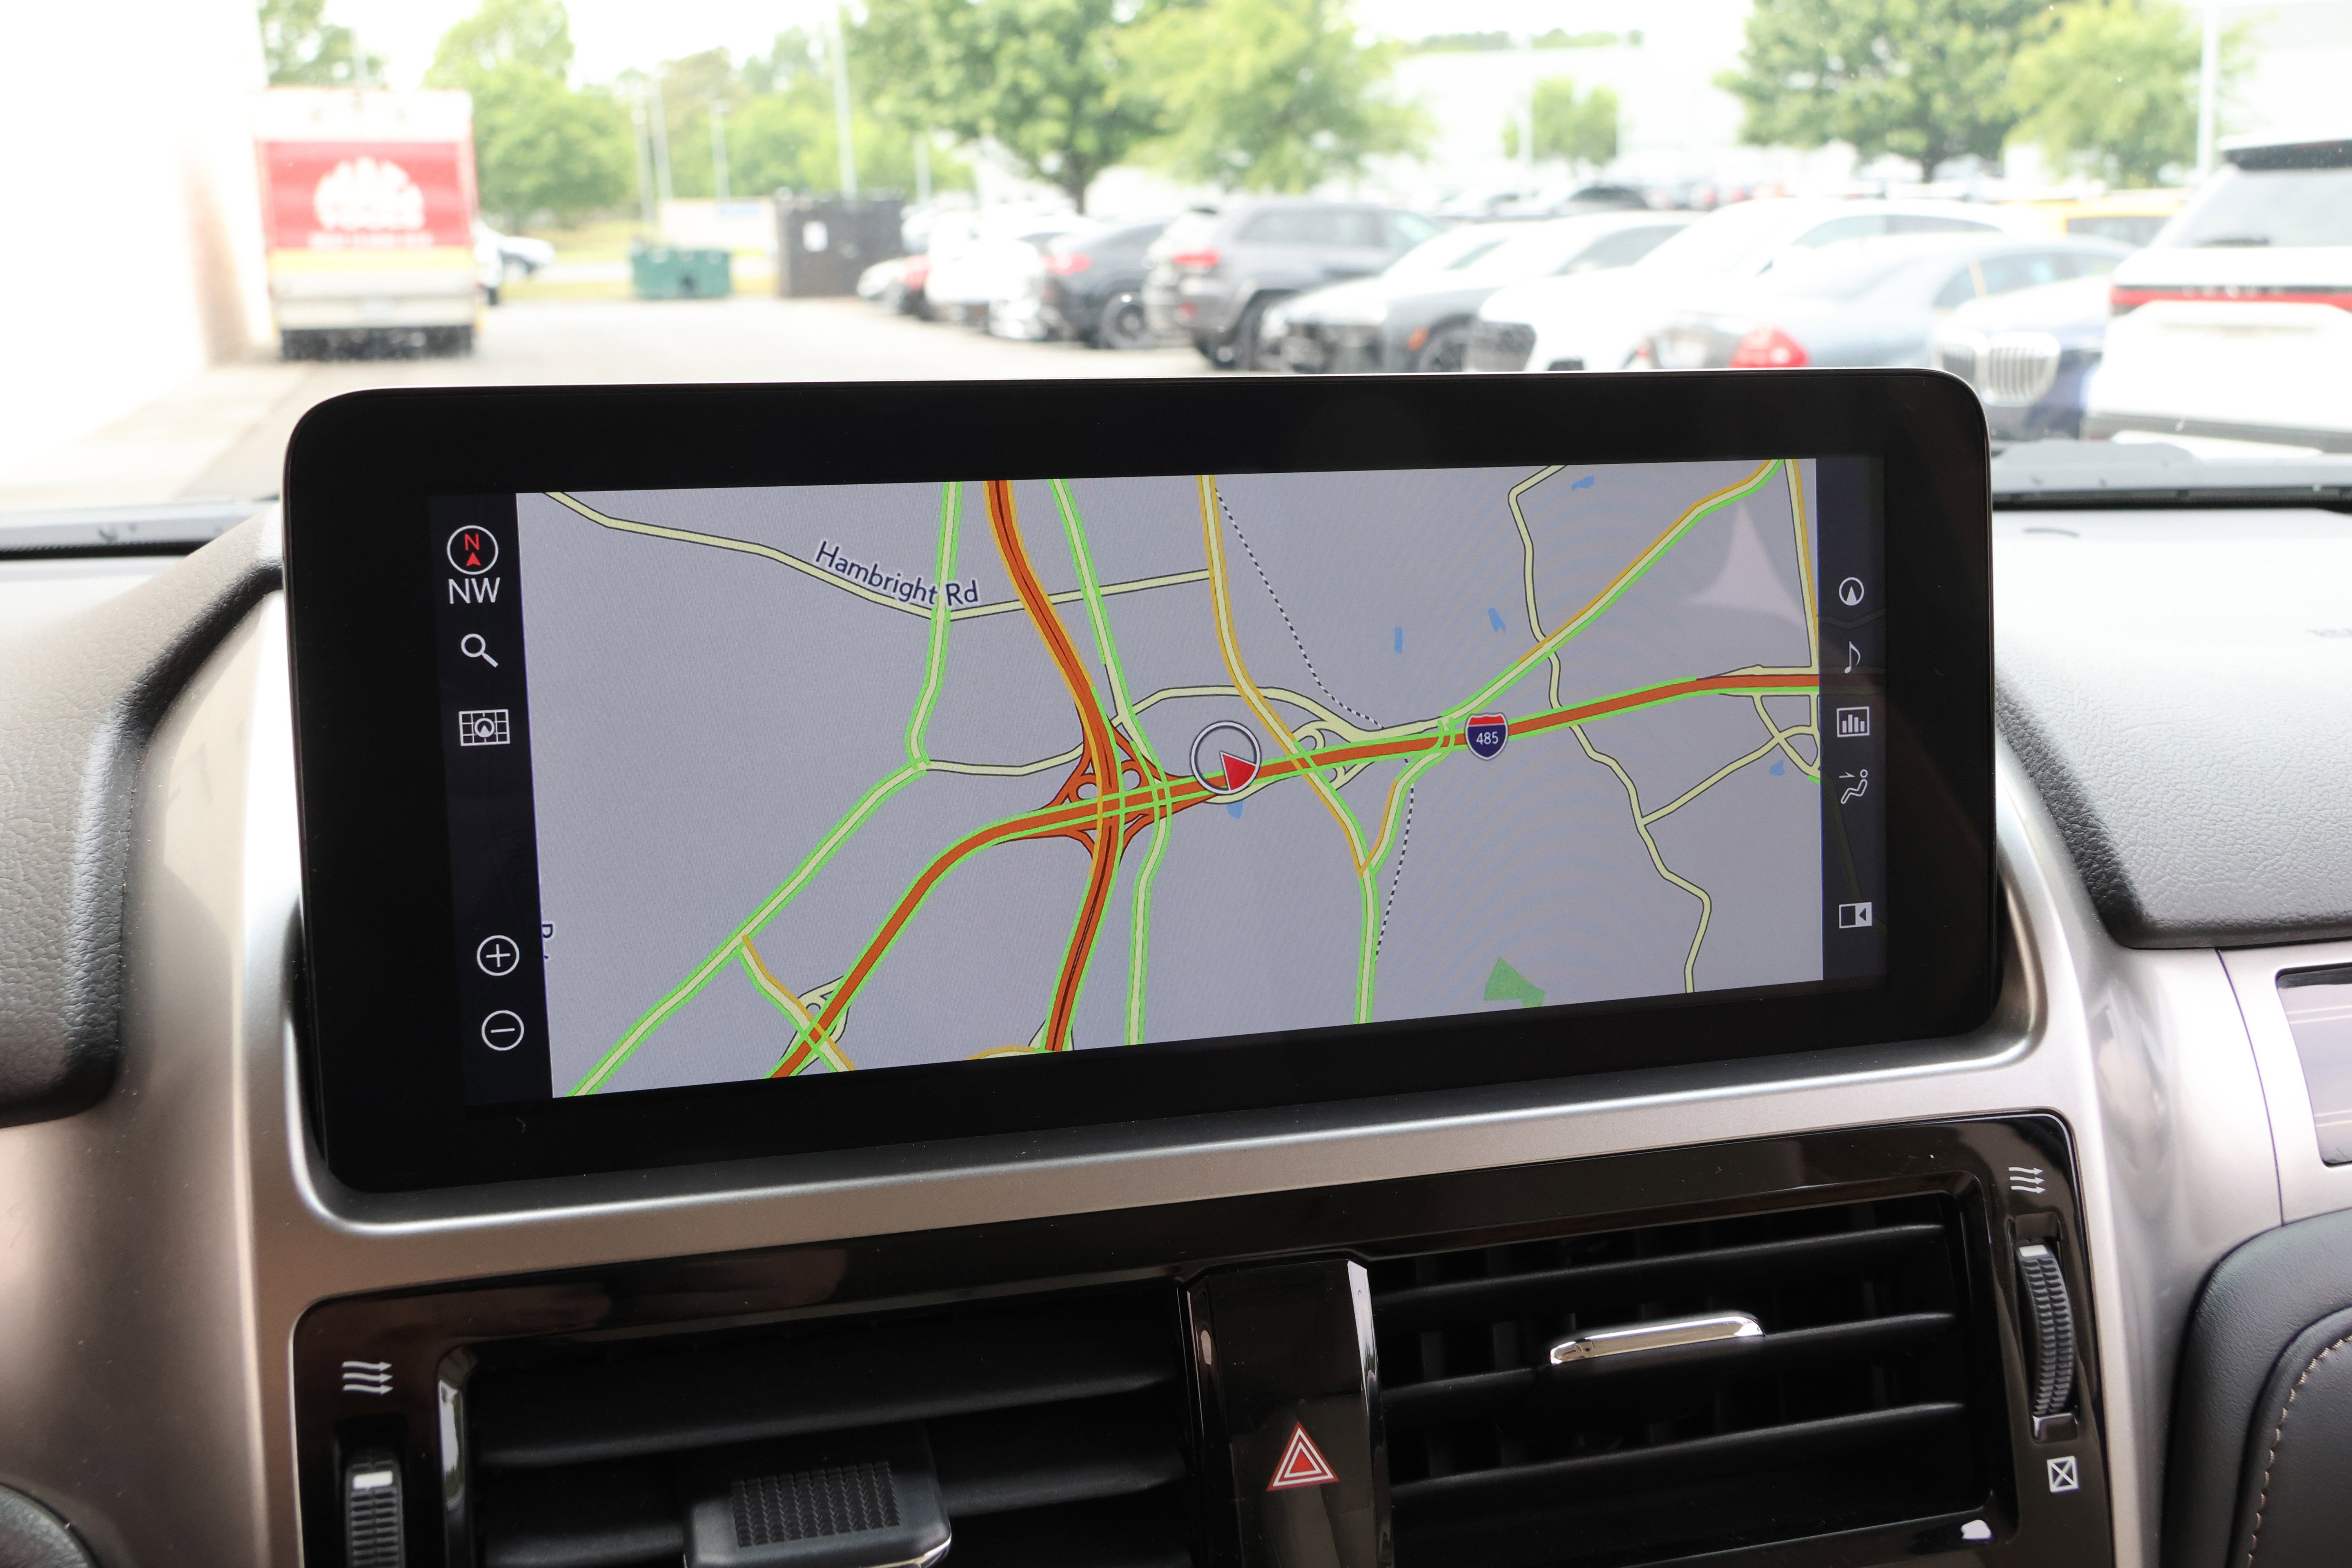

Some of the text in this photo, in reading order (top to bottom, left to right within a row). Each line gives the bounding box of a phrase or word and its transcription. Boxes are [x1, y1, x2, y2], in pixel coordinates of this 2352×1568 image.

[464, 533, 480, 551] N
[815, 540, 978, 606] Hambright Rd
[448, 577, 501, 605] NW
[1476, 731, 1499, 745] 485
